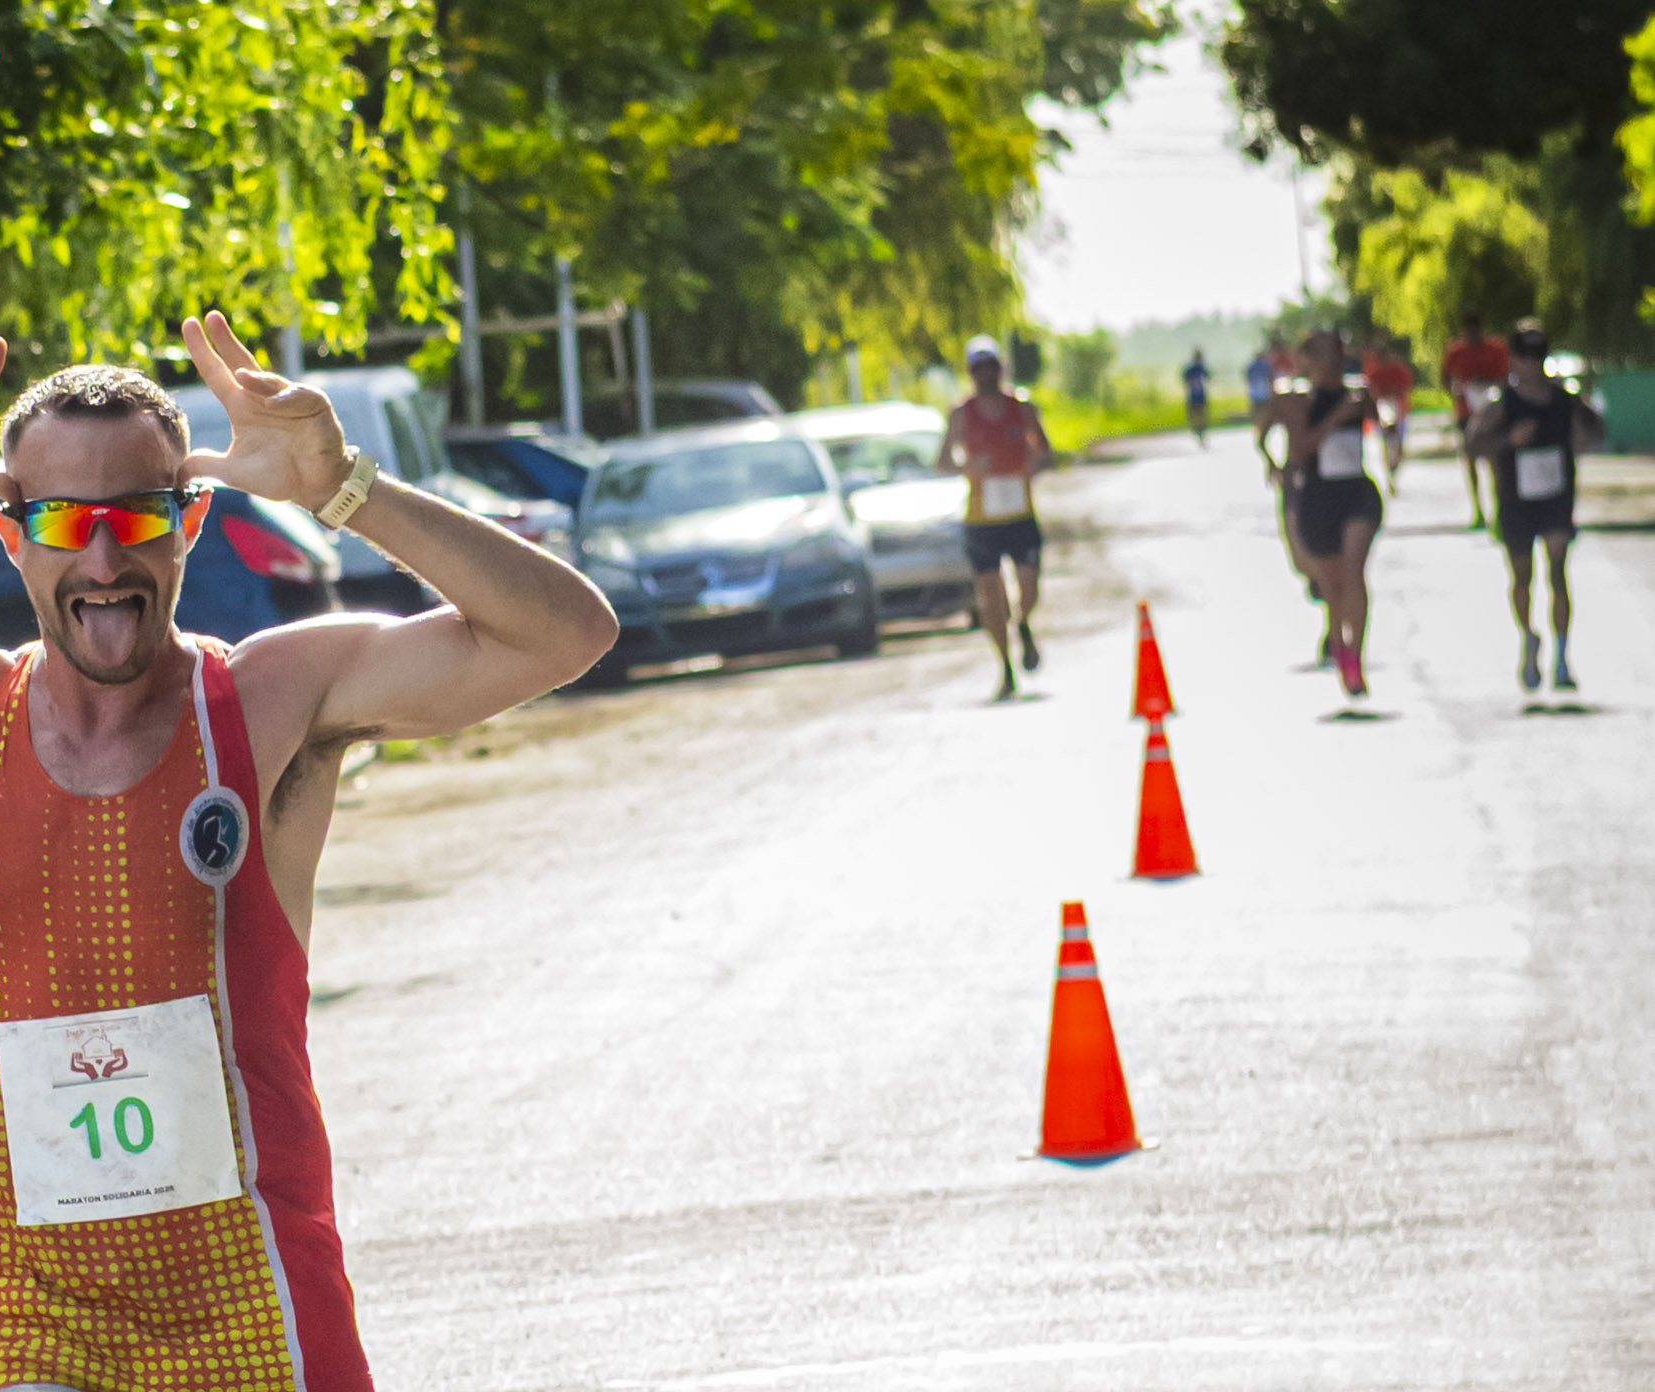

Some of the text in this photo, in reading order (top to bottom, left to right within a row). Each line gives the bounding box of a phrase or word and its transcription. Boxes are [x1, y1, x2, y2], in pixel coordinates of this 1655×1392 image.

[69, 1096, 154, 1160] 10
[57, 1196, 101, 1205] MARATON
[103, 1189, 151, 1201] SOLIDARIA
